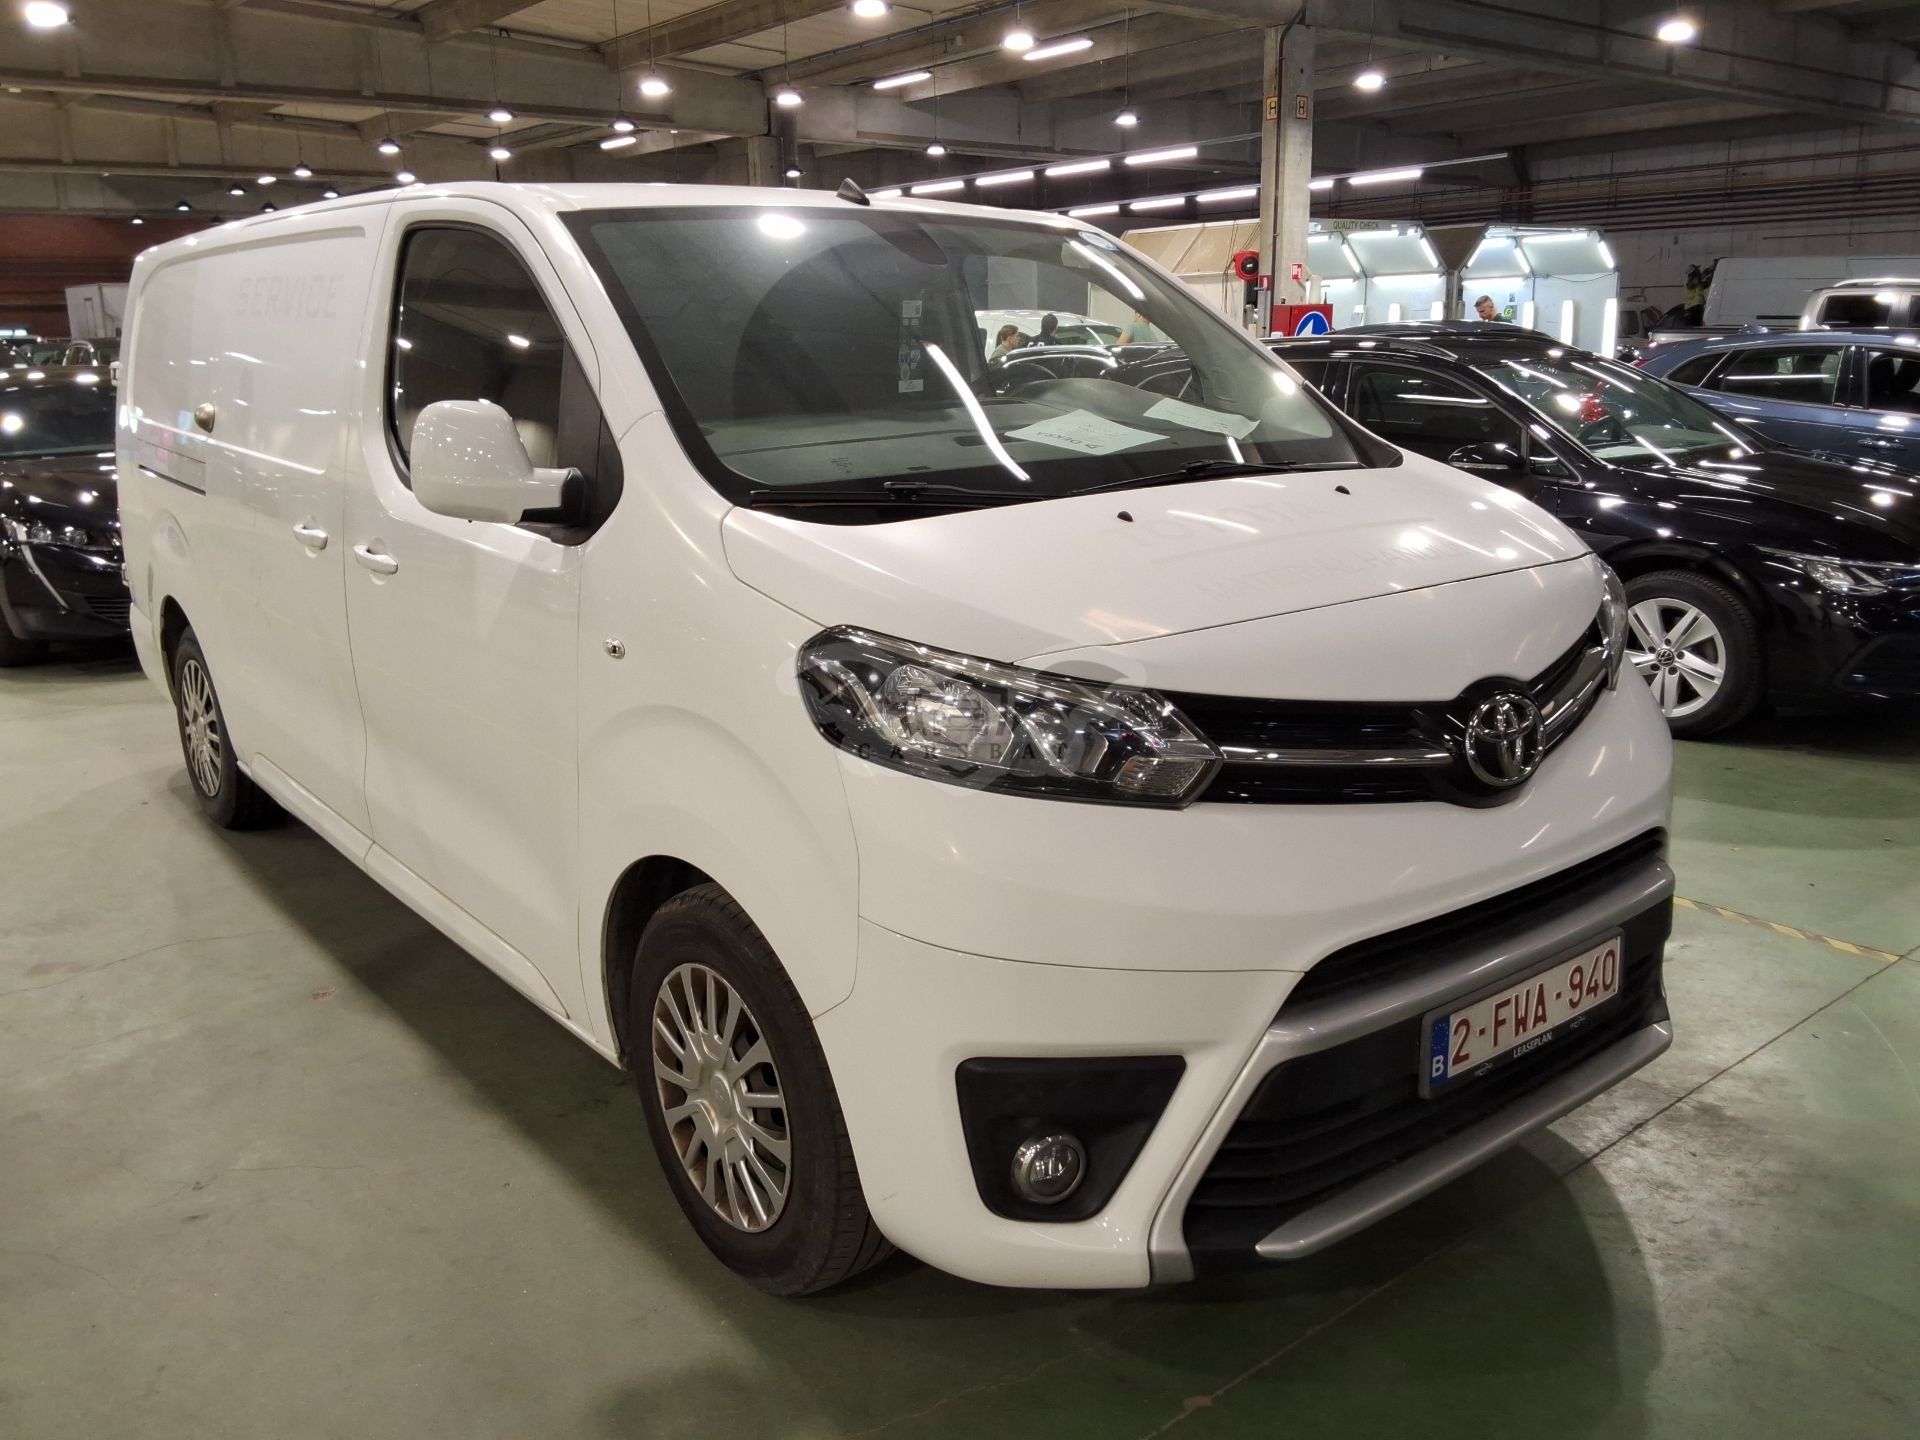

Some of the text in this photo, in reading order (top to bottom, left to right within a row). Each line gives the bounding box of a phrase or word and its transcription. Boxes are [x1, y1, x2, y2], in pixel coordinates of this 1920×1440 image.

[1333, 220, 1379, 230] QUALITY CHECK
[235, 274, 344, 318] SERVICE
[1451, 949, 1616, 1066] 2-FWA-940
[1512, 1032, 1553, 1058] LEASEPLAN
[1432, 1055, 1444, 1078] B
